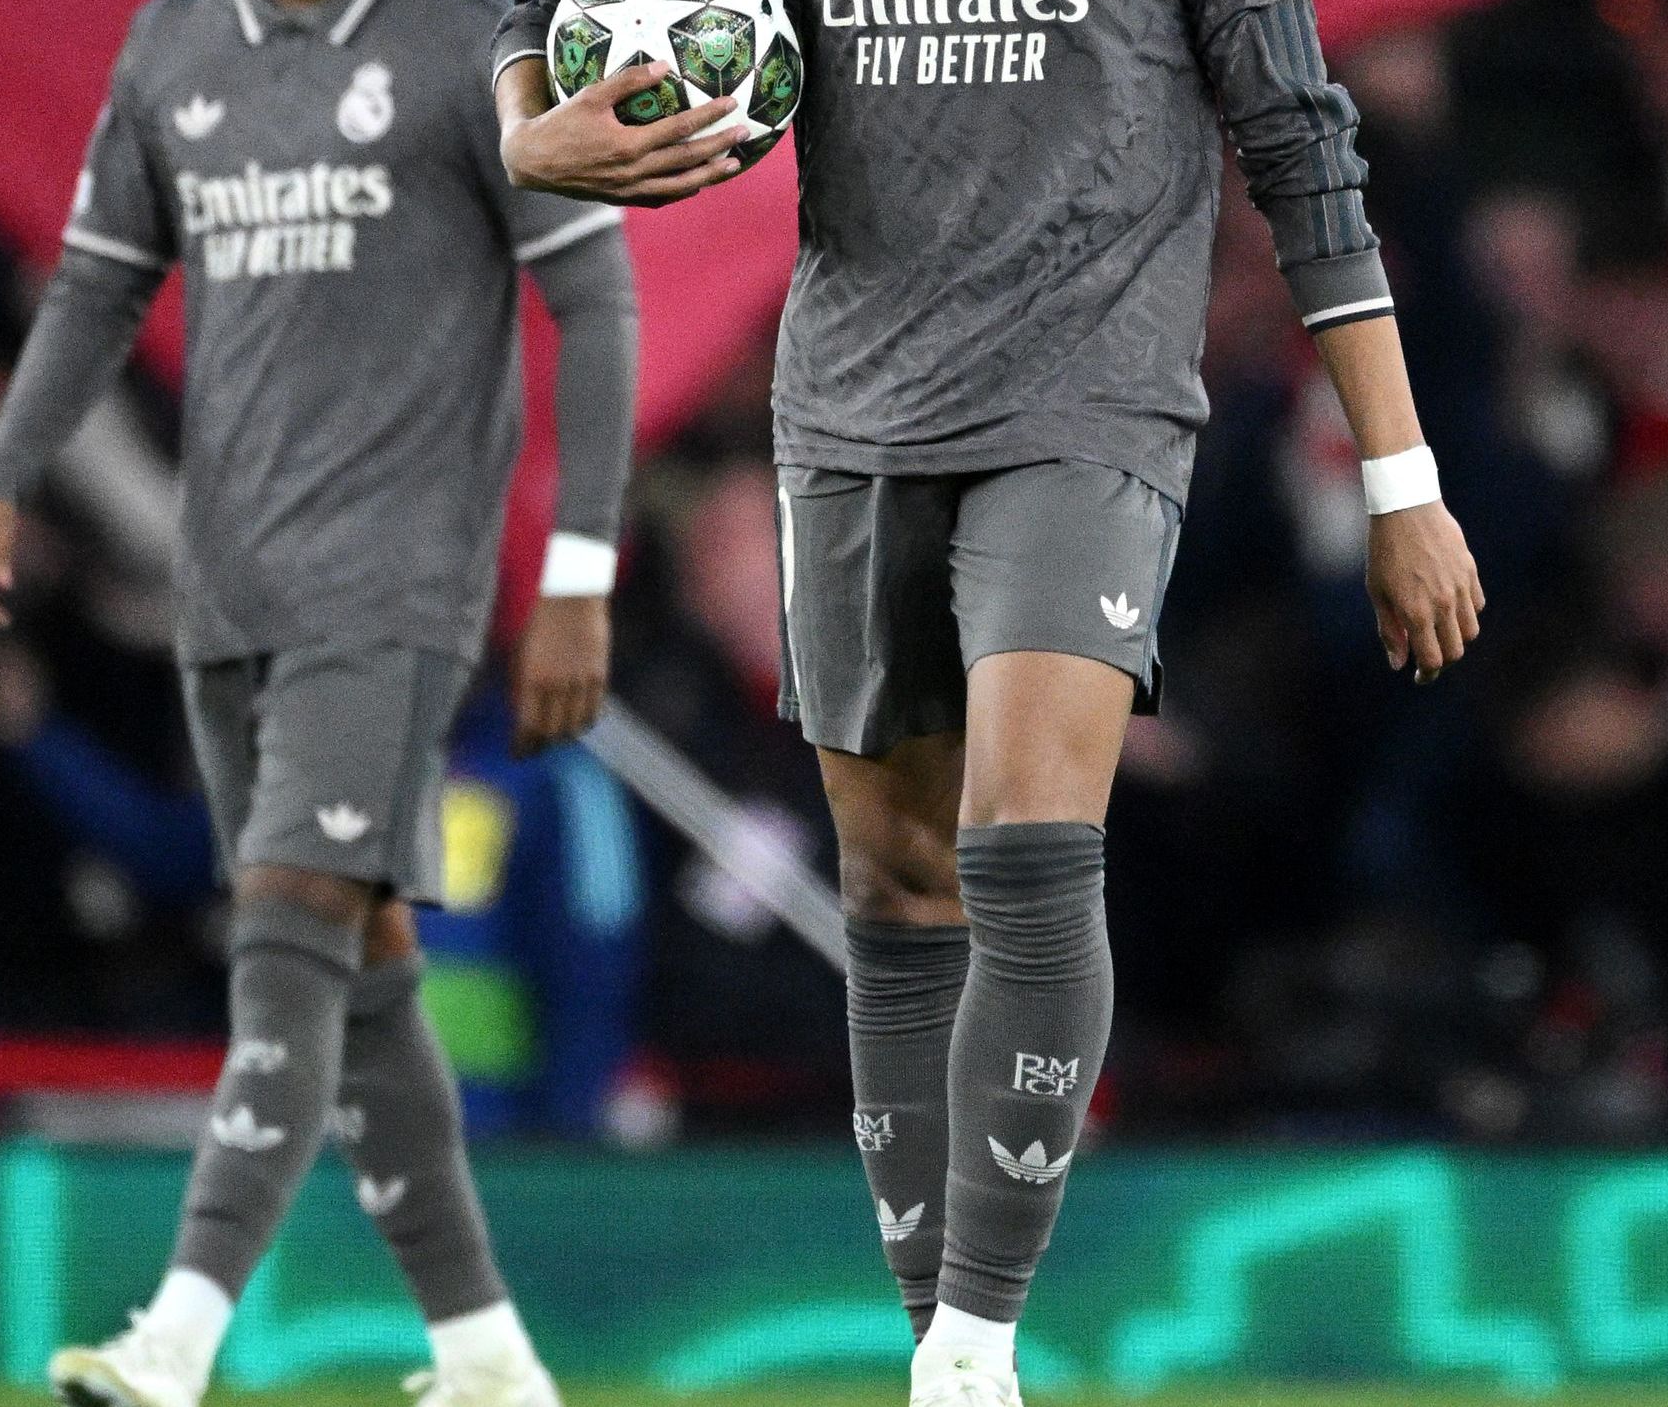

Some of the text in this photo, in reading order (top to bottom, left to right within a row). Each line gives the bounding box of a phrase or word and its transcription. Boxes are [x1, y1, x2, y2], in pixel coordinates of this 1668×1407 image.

[856, 33, 1046, 85] FLY BETTER
[176, 161, 393, 235] Emirates
